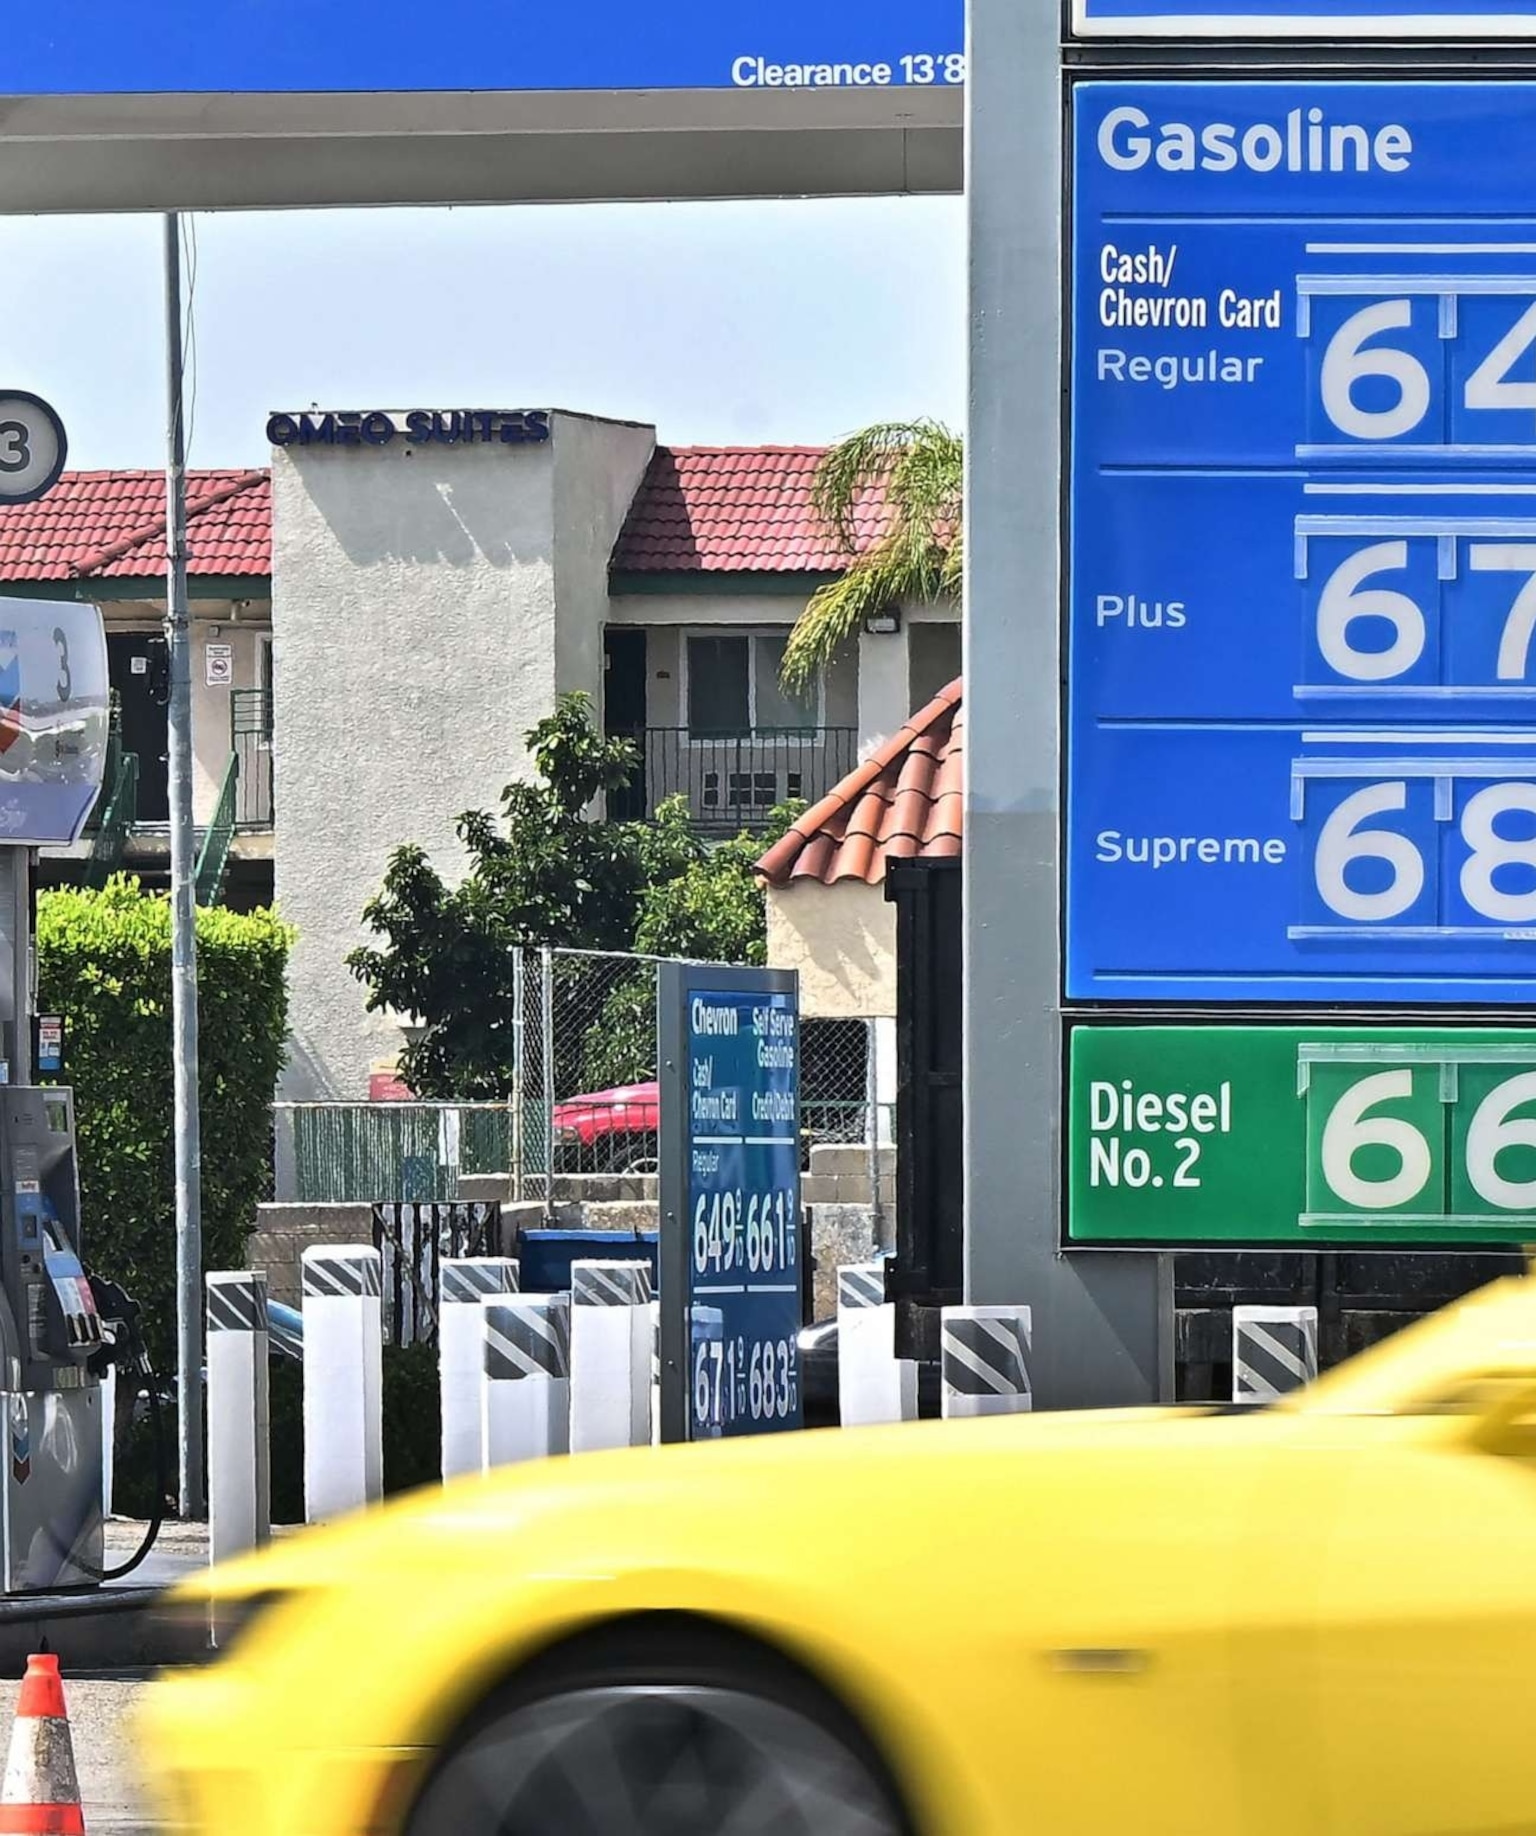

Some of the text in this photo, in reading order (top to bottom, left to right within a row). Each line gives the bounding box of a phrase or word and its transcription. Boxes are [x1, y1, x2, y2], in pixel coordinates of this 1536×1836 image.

[731, 56, 892, 86] Clearance
[1097, 106, 1413, 172] Gasoline
[1100, 243, 1177, 287] Cash/
[1100, 288, 1280, 328] Chevron Card
[1097, 348, 1264, 389] Regular
[0, 421, 30, 472] 3
[405, 411, 549, 444] SUITES
[1095, 595, 1187, 628] Plus
[53, 627, 72, 700] 3
[1095, 830, 1287, 869] Supreme
[692, 997, 738, 1036] Chevron
[752, 1006, 794, 1036] Self Serve
[693, 1055, 713, 1090] Cash/
[757, 1038, 794, 1068] Gasoline
[693, 1090, 736, 1120] Chevron Card
[1090, 1080, 1231, 1133] Diesel
[693, 1150, 719, 1177] Regular
[1090, 1138, 1200, 1187] No. 2
[694, 1191, 735, 1273] 649
[747, 1191, 785, 1273] 661
[695, 1340, 735, 1422] 671
[750, 1340, 789, 1420] 683
